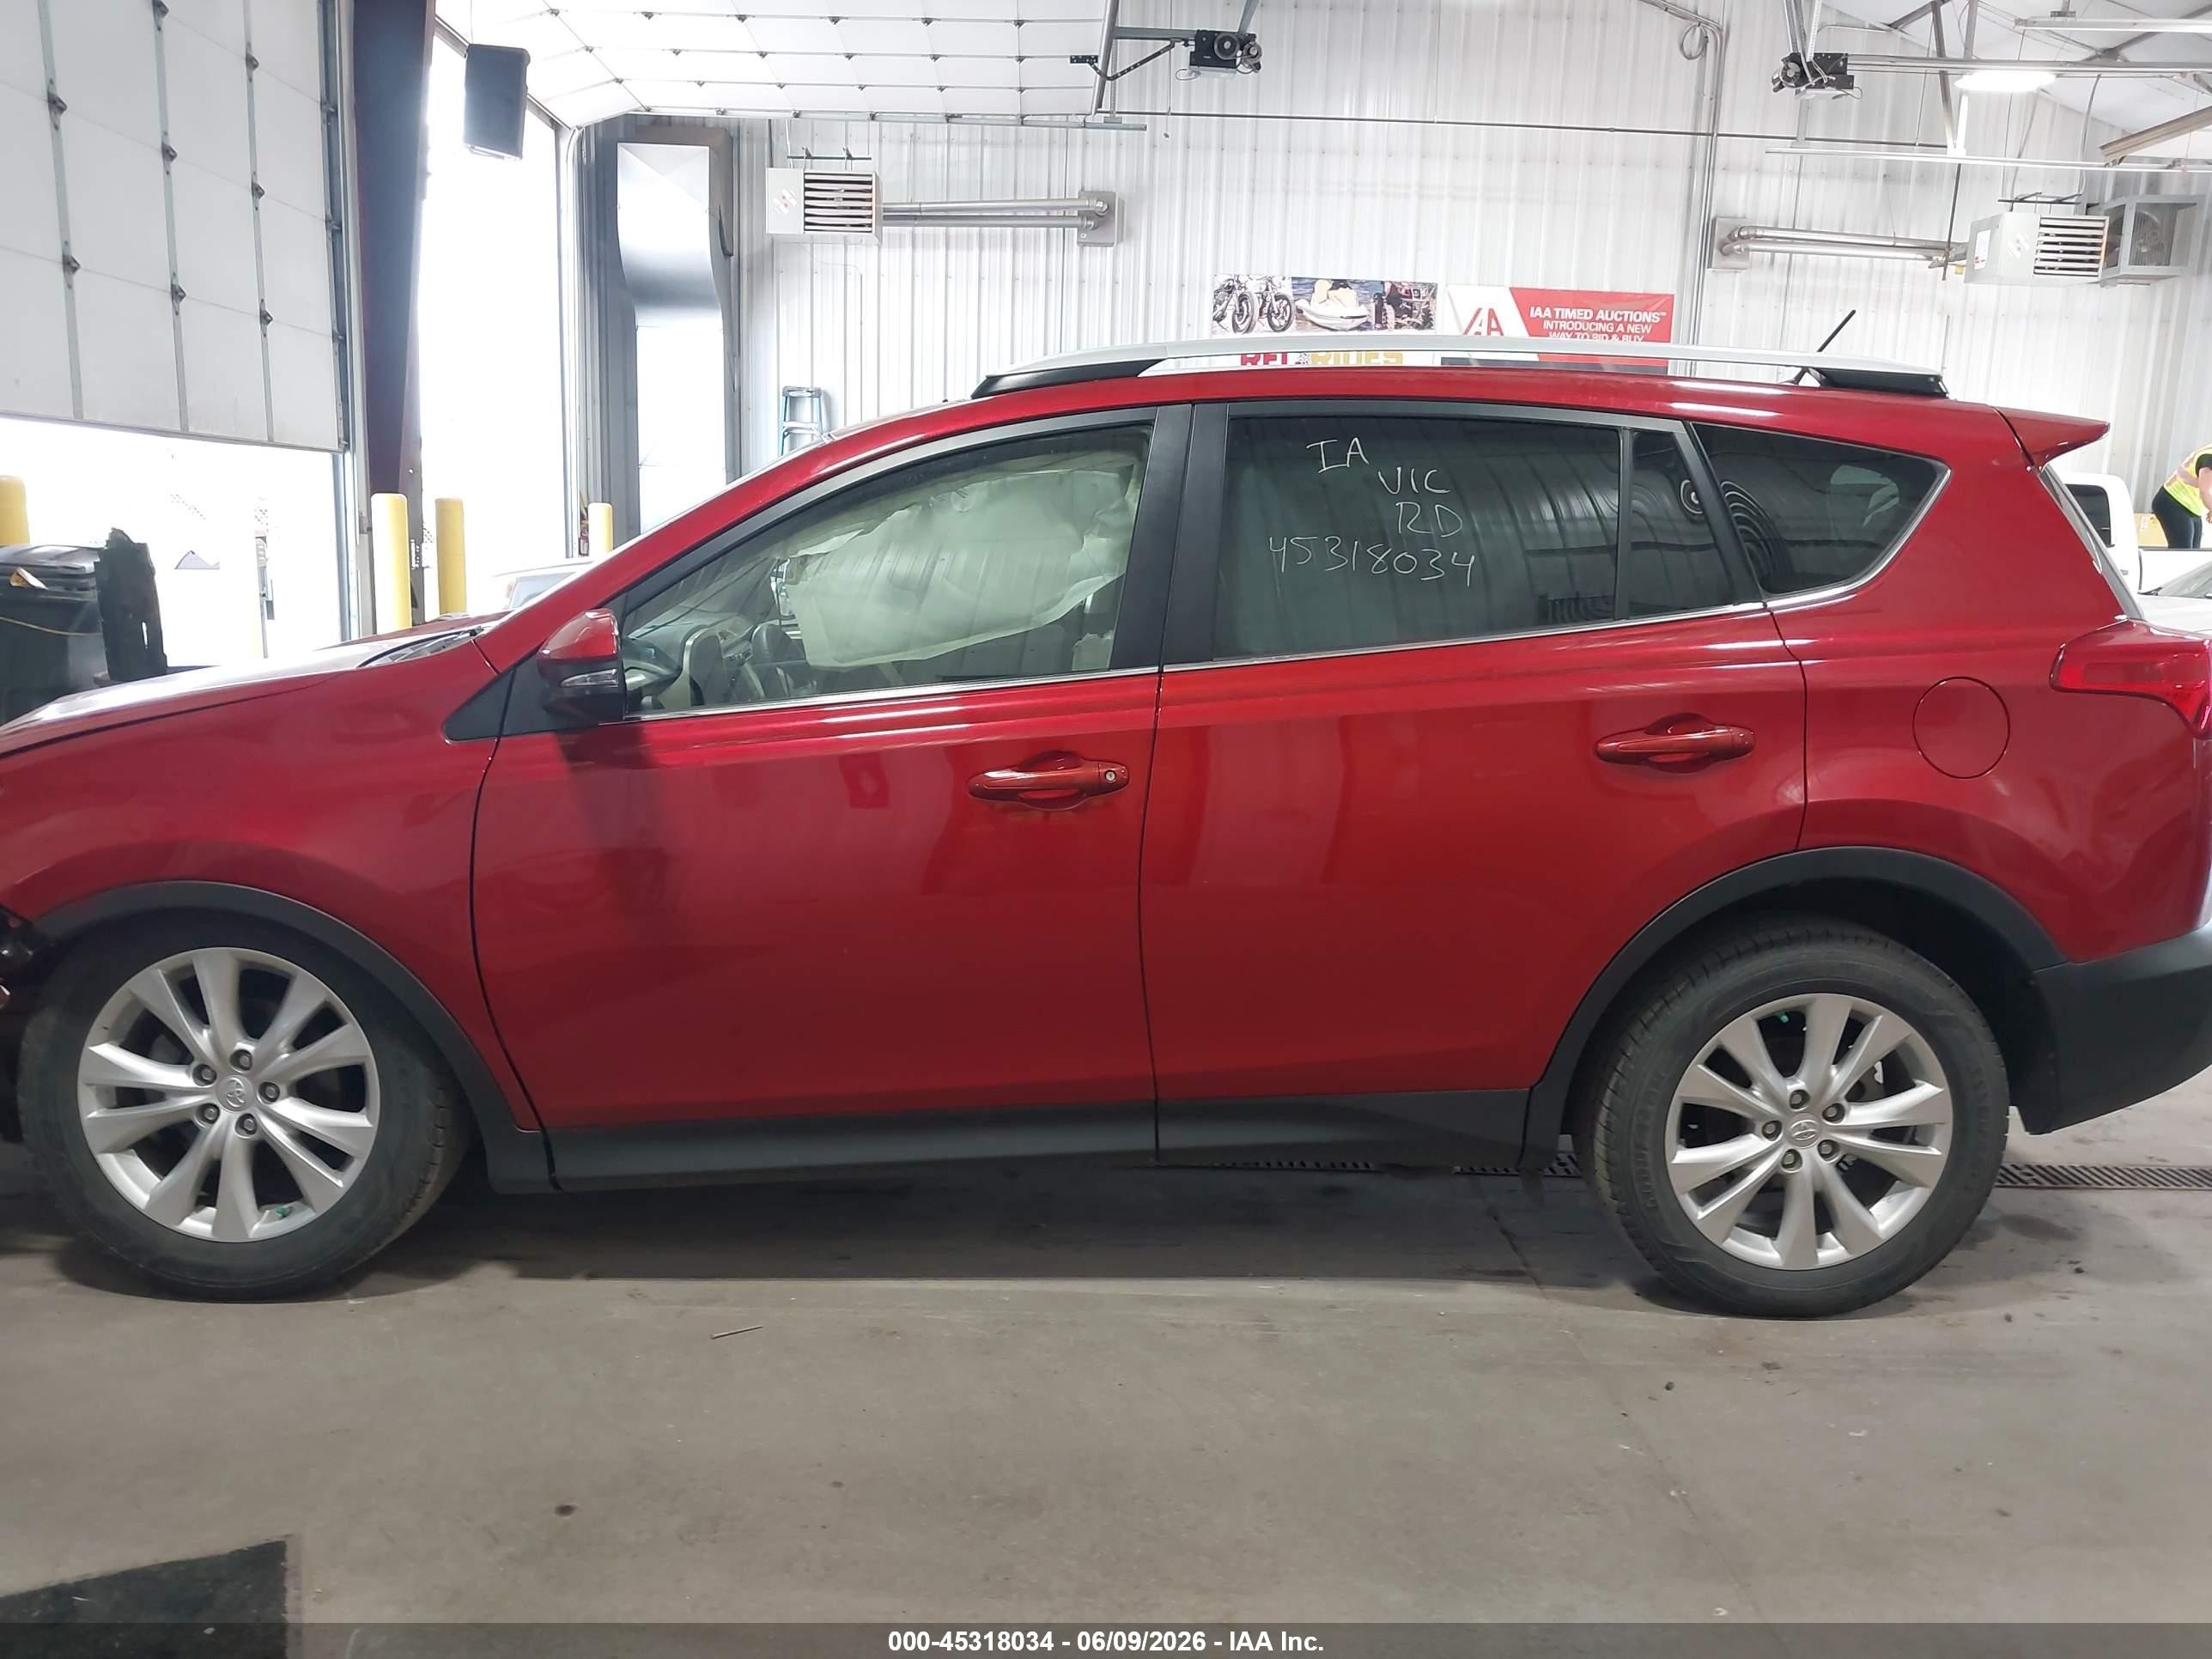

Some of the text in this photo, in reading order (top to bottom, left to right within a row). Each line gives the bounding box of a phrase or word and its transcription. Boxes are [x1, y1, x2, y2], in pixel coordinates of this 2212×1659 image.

[1529, 307, 1552, 319] IAA
[1553, 307, 1594, 320] TIMED
[1543, 320, 1652, 334] INTRODUCING A NEW
[1306, 437, 1370, 473] IA
[1269, 536, 1476, 586] 45318034
